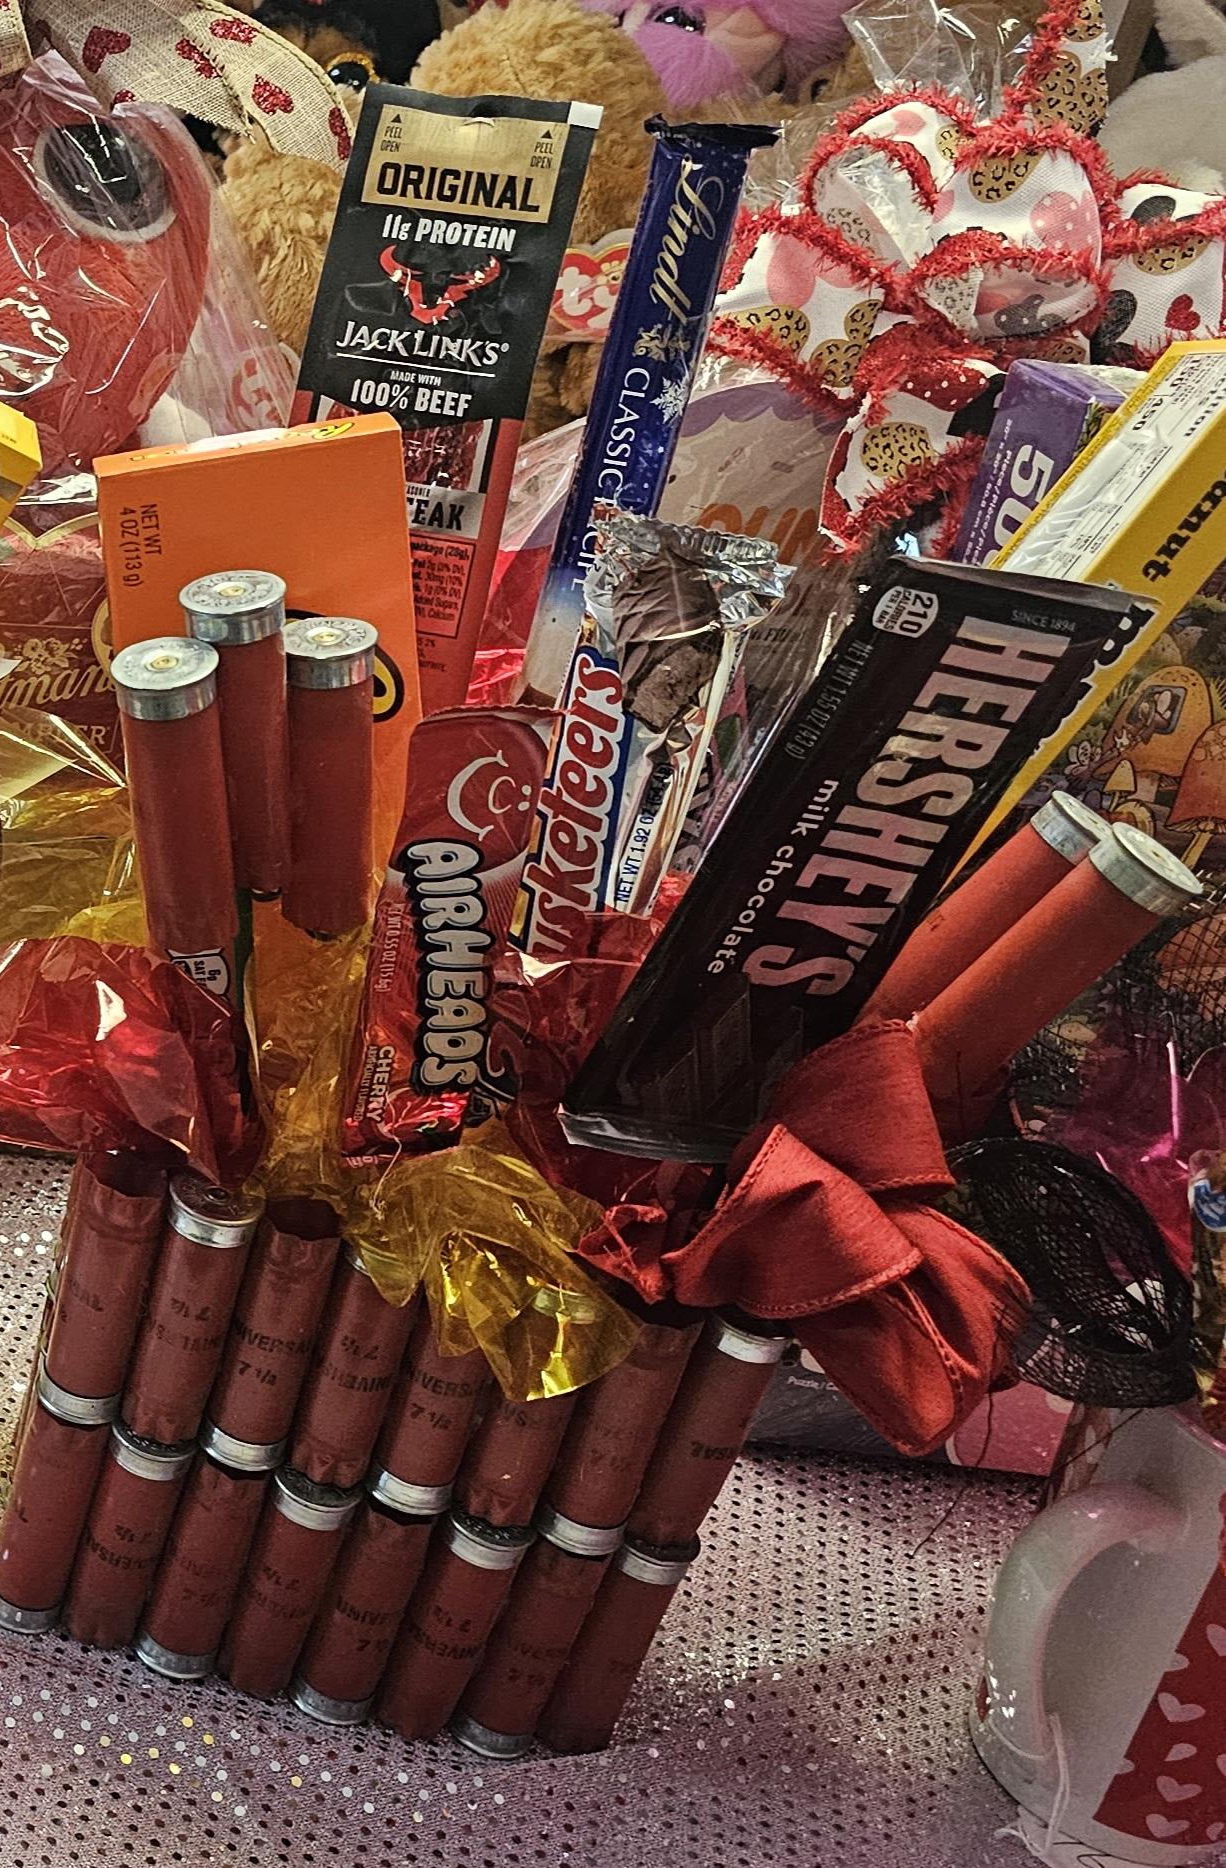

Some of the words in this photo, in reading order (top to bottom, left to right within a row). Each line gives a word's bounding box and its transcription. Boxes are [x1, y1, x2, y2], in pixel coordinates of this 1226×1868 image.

[384, 126, 402, 139] PEEL
[380, 140, 400, 153] OPEN
[534, 142, 553, 155] PEEL
[530, 156, 553, 169] OPEN
[376, 161, 540, 213] ORIGINAL
[414, 217, 517, 252] PROTEIN
[649, 157, 725, 327] Lindt
[336, 320, 411, 357] JACK
[390, 370, 416, 383] MADE
[418, 373, 442, 386] WITH
[350, 378, 410, 410] 100%
[414, 387, 473, 418] BEEF
[598, 367, 651, 493] CLASSIC
[119, 507, 137, 516] 4
[140, 503, 160, 530] NET
[120, 519, 140, 538] OZ
[119, 541, 143, 571] (113
[143, 533, 162, 556] WT
[122, 573, 144, 587] g)
[883, 588, 913, 631] CALORIES
[899, 593, 934, 634] 210
[1011, 609, 1048, 628] SINCE
[845, 639, 873, 666] NET
[831, 664, 859, 686] WT
[806, 707, 831, 729] OZ
[741, 616, 1072, 997] HERSHEY'S
[794, 778, 840, 837] milk
[631, 827, 651, 853] 1.92
[624, 856, 641, 880] WT
[616, 881, 633, 903] NET
[706, 843, 794, 974] chocolate
[193, 960, 206, 976] SAT
[407, 841, 492, 1087] AIRHEADS
[365, 1044, 395, 1123] CHERRY
[237, 1360, 253, 1377] 7
